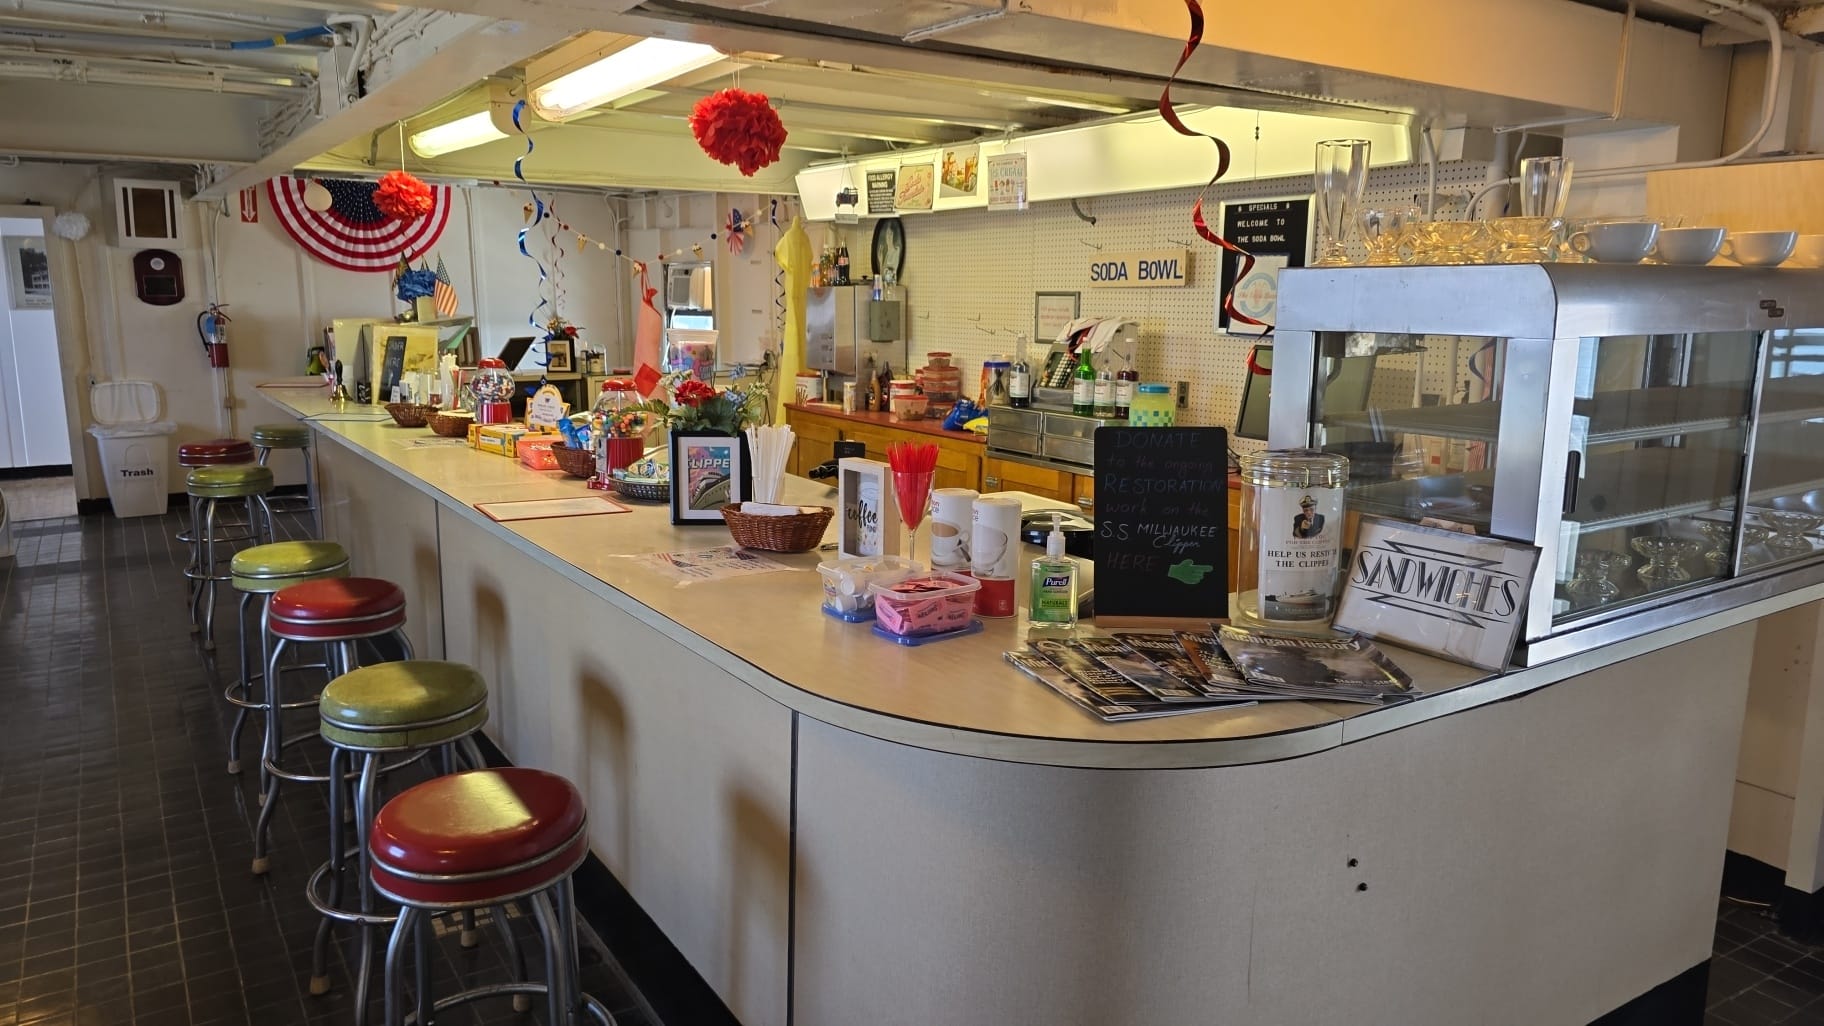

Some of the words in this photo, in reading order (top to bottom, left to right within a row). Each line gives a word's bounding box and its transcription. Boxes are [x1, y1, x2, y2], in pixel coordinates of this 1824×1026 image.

[1237, 219, 1269, 228] WELCOME
[1276, 218, 1285, 226] TO
[1237, 235, 1249, 243] THE
[1269, 234, 1286, 242] BOWL
[1090, 262, 1128, 281] SODA
[1138, 259, 1184, 281] BOWL
[1114, 430, 1201, 449] DONATE
[1106, 453, 1125, 467] to
[1135, 455, 1154, 468] the
[120, 468, 154, 478] Trash
[1104, 472, 1224, 494] RESTORATION
[846, 499, 879, 529] coffee
[1105, 498, 1147, 514] work
[1164, 506, 1180, 515] on
[1185, 501, 1209, 516] the
[1106, 551, 1158, 571] HERE
[1267, 550, 1292, 558] HELP
[1295, 550, 1307, 558] US
[1276, 560, 1295, 568] THE
[1298, 559, 1329, 568] CLIPPE
[1045, 577, 1068, 586] Purell
[1351, 550, 1520, 617] SANDWICHES
[1219, 626, 1297, 648] Michigan
[1300, 637, 1361, 651] History
